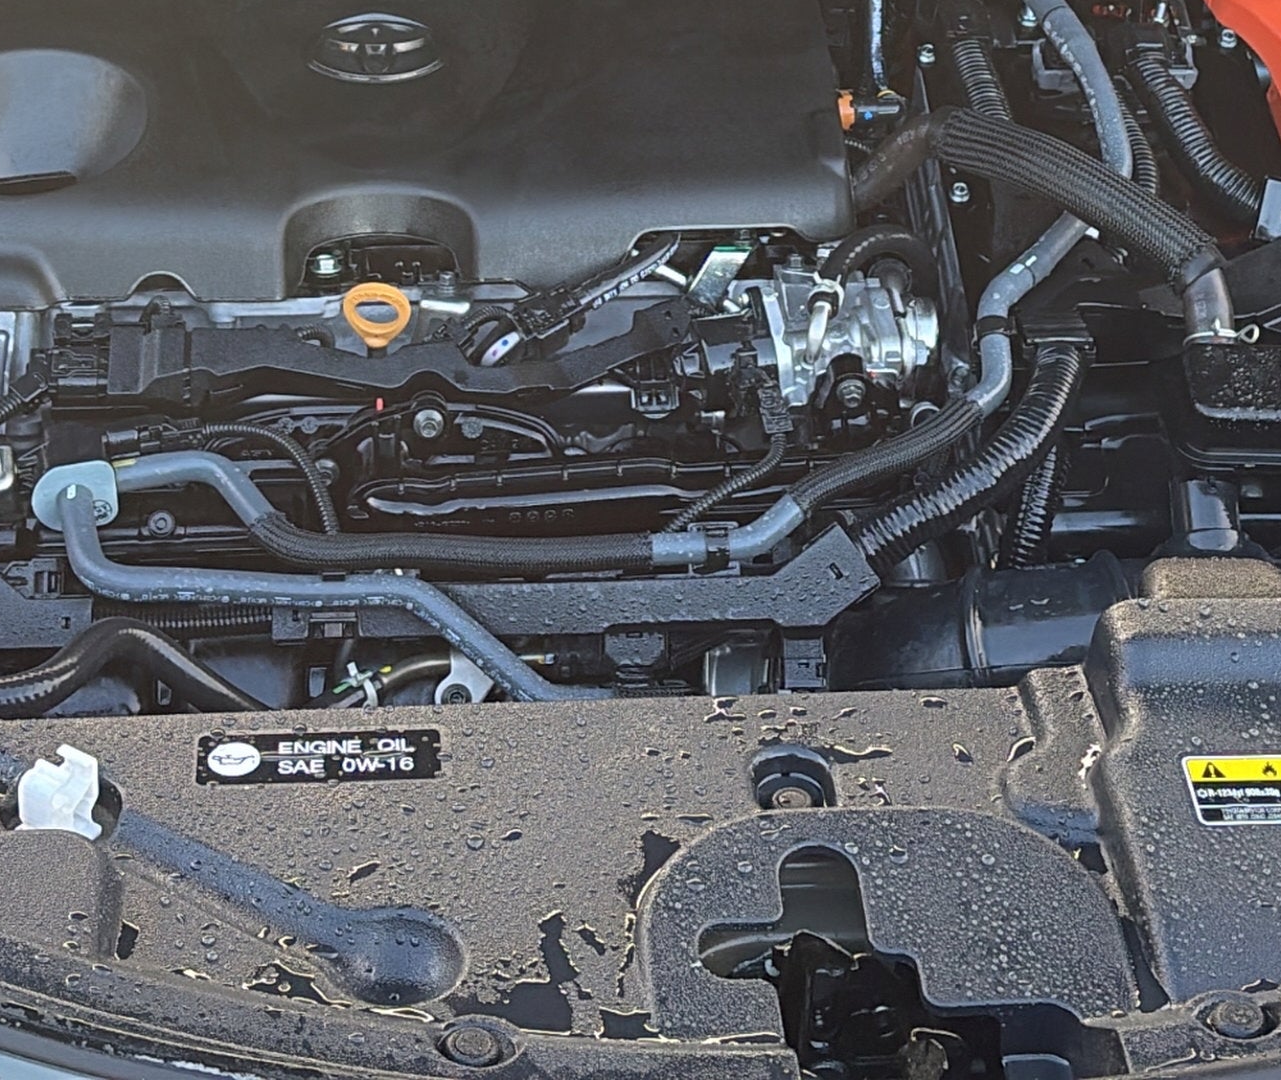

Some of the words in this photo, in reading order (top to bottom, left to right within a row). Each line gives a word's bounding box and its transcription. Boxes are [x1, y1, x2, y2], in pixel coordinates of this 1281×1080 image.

[277, 739, 363, 755] ENGINE
[377, 737, 416, 753] OIL
[277, 758, 326, 775] SAE
[342, 756, 415, 773] 0W-16
